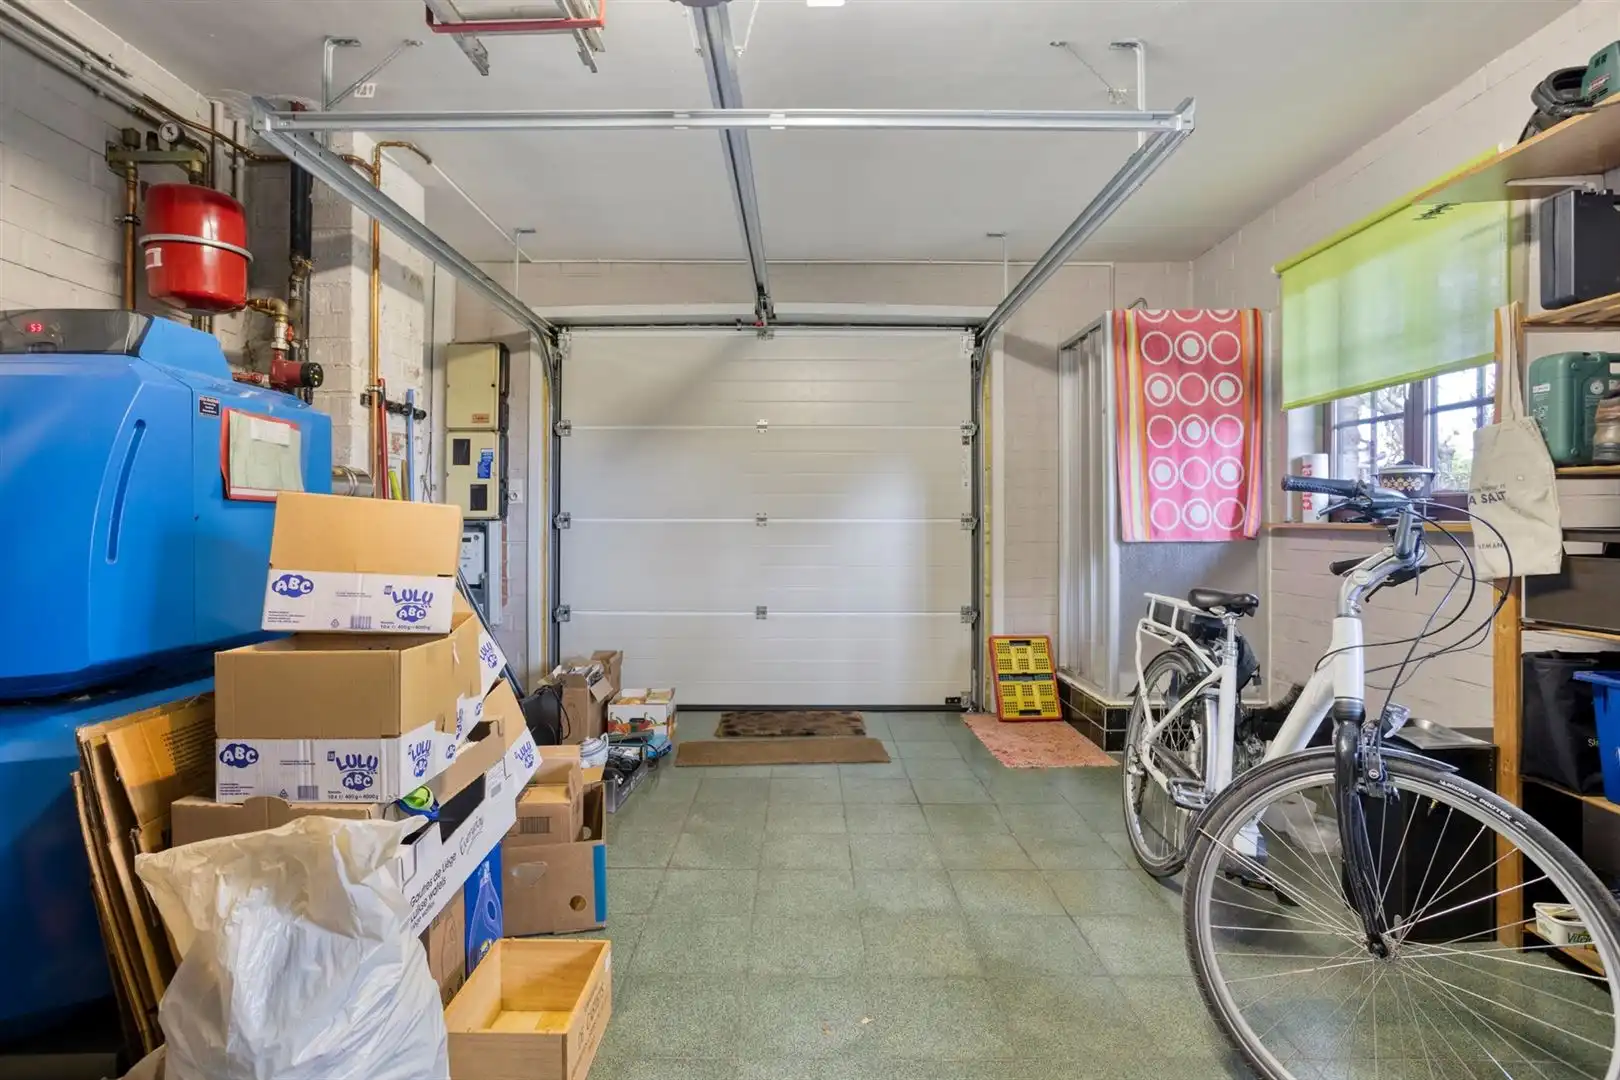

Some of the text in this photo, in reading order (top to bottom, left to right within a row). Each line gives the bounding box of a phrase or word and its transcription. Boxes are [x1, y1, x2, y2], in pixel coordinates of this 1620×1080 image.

[275, 577, 312, 593] ABC
[392, 589, 434, 605] LULU
[399, 607, 424, 619] ABC
[223, 746, 256, 763] ABC
[336, 754, 378, 771] LULU
[345, 774, 371, 787] ABC
[1480, 798, 1512, 820] PROTEK
